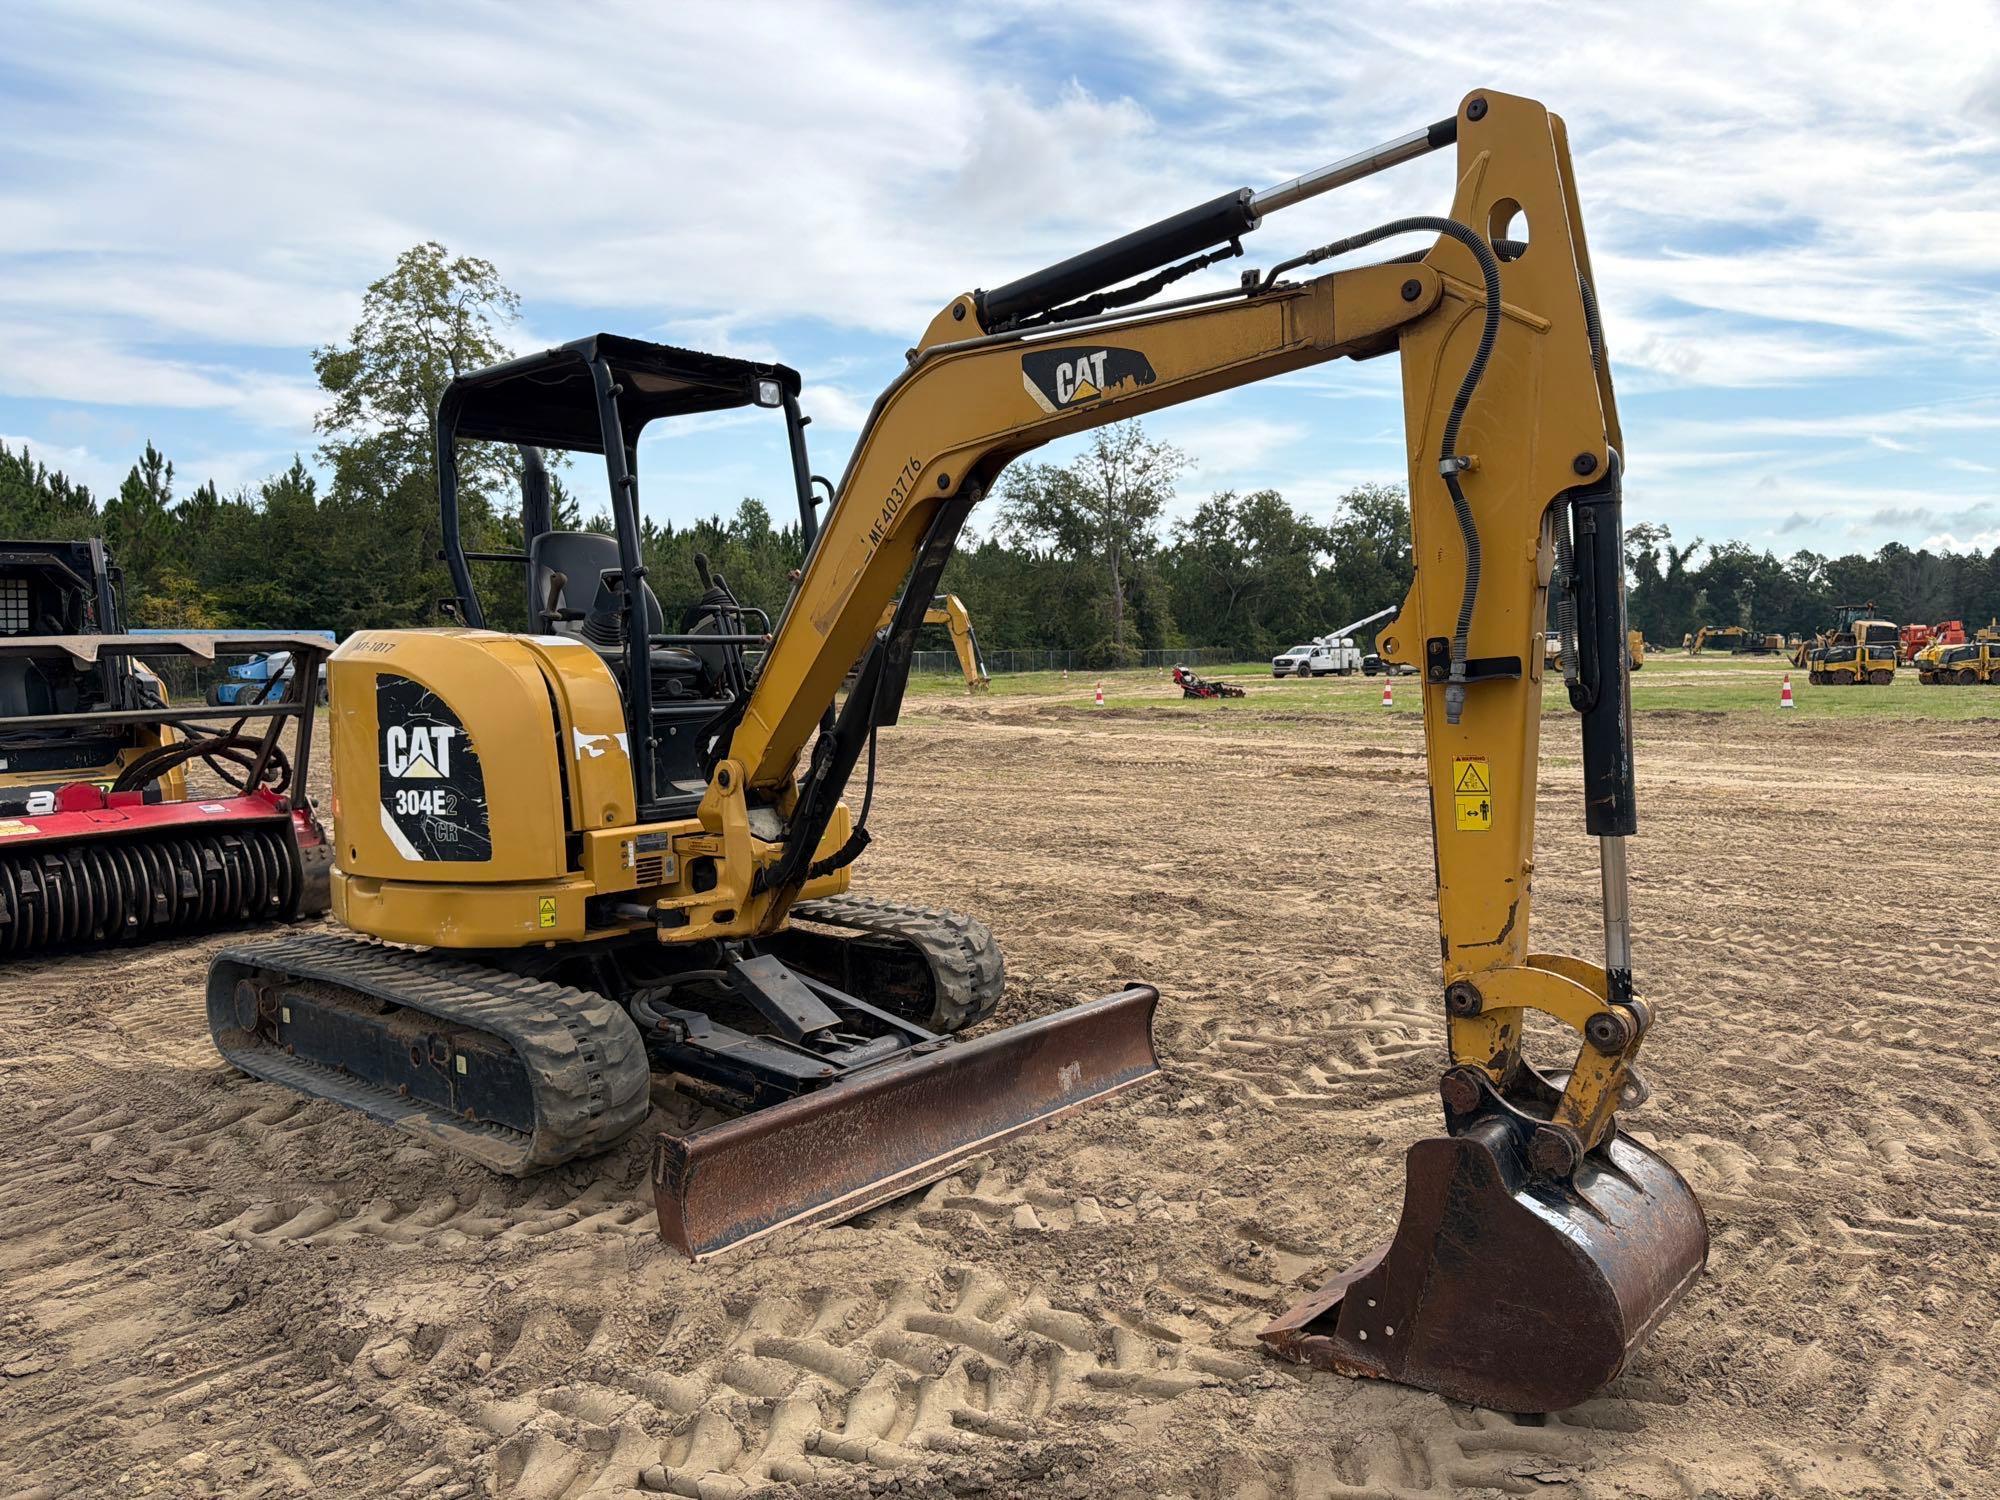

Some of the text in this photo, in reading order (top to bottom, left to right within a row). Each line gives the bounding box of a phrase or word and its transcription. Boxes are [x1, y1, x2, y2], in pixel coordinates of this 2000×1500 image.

[1056, 350, 1107, 404] CAT
[387, 725, 455, 778] CAT
[395, 789, 458, 815] 304E2
[434, 821, 459, 841] CR
